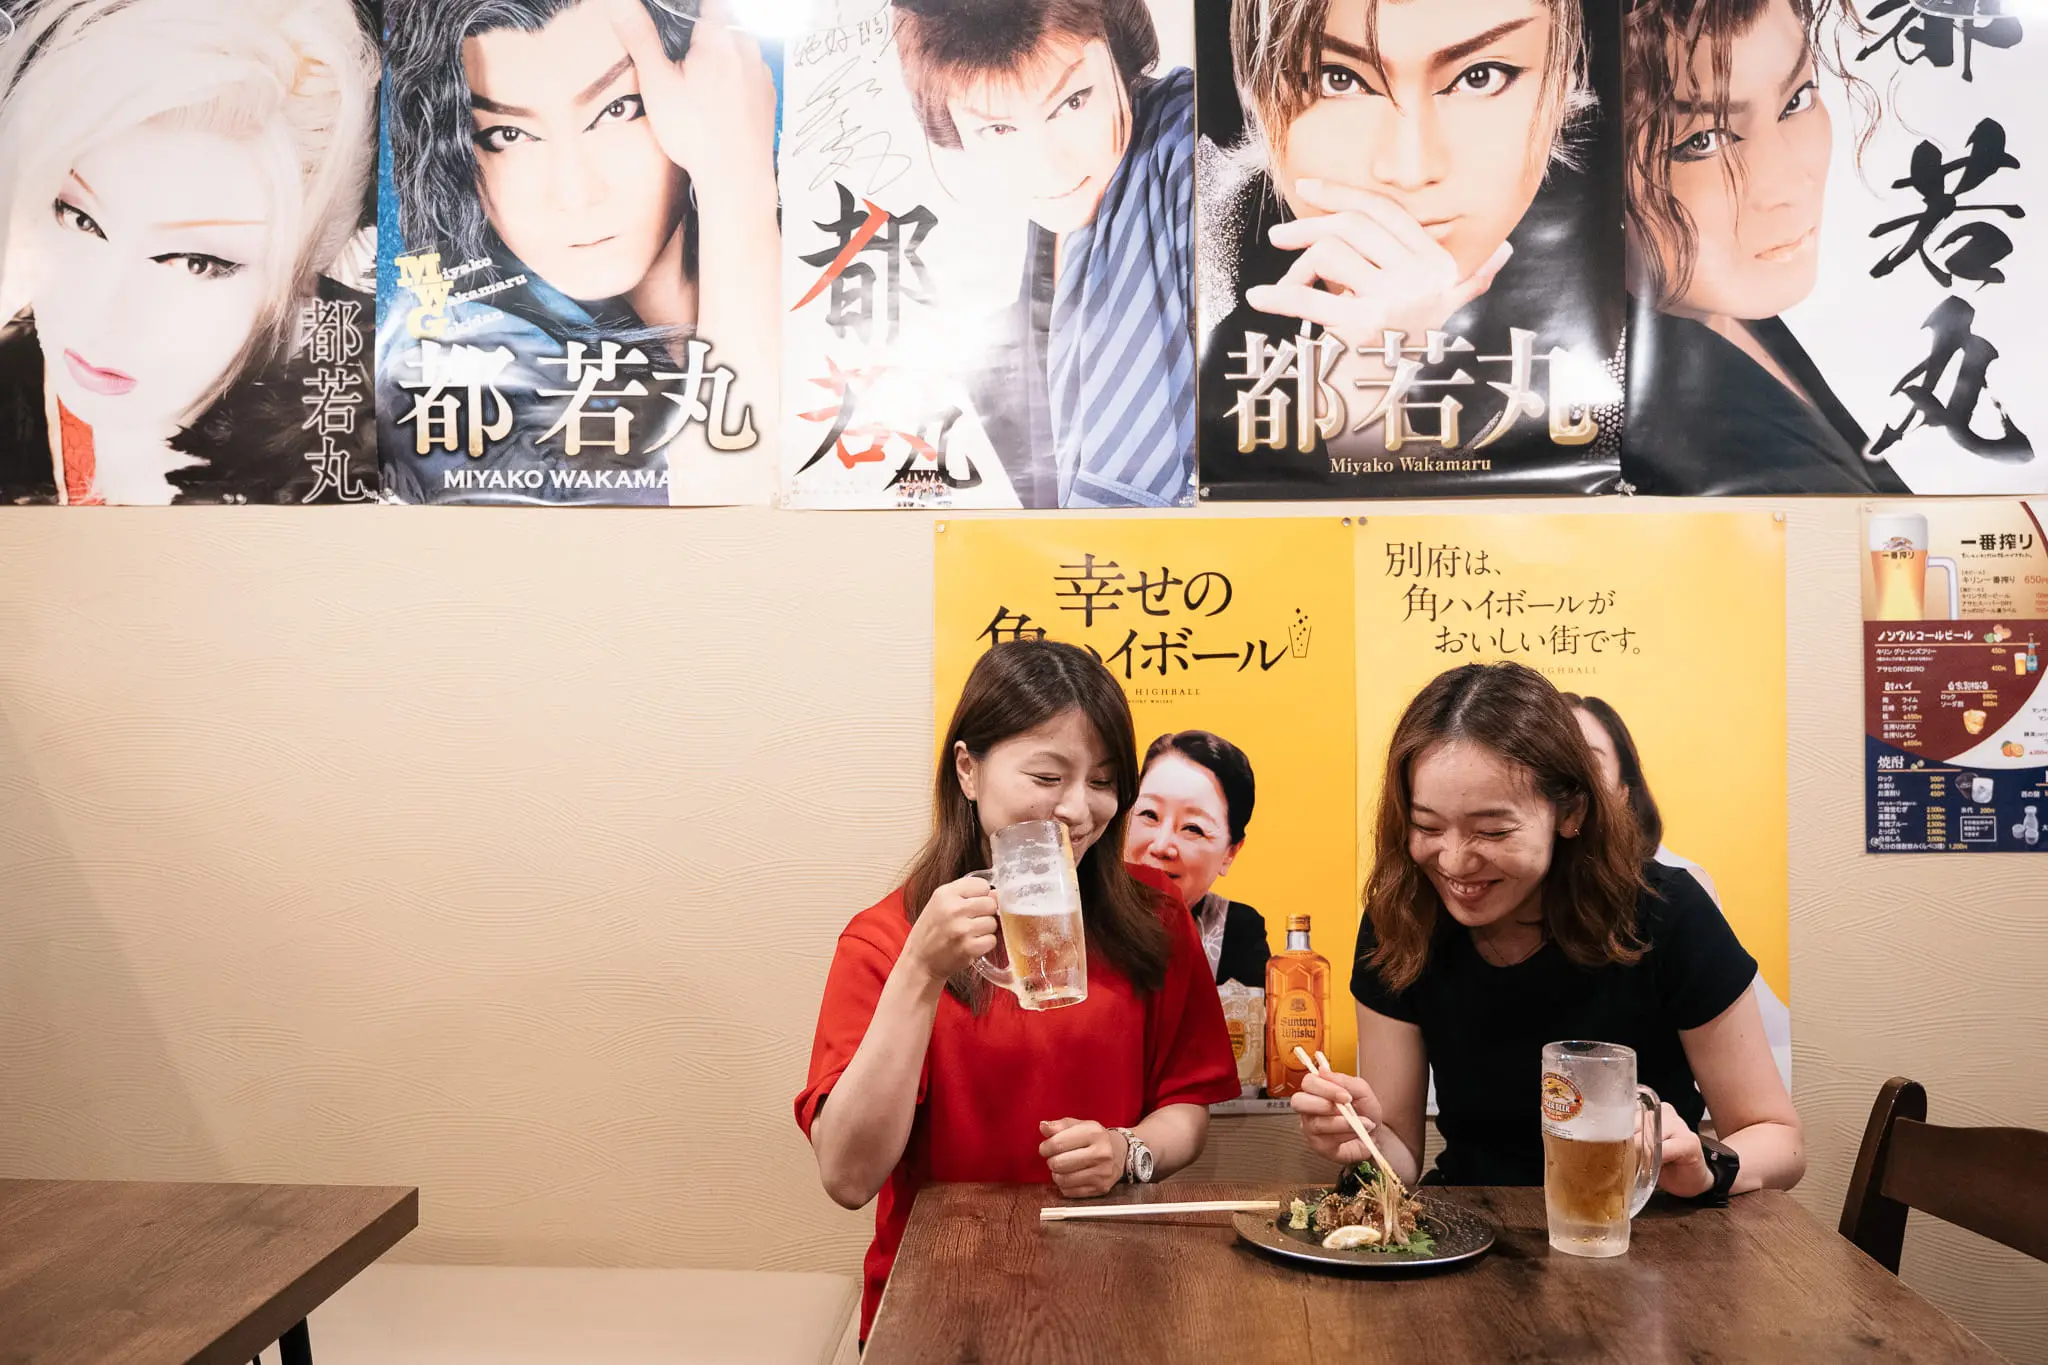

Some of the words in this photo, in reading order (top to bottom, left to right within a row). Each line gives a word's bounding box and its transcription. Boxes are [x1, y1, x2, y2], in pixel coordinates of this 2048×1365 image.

[301, 298, 366, 503] 都若丸
[397, 338, 759, 458] 都若丸
[1225, 330, 1600, 454] 都若丸
[1330, 458, 1394, 475] Miyako
[1400, 457, 1491, 471] Wakamaru
[443, 470, 544, 489] MIYAKO
[1961, 533, 2033, 551] 一番搾り
[1385, 541, 1502, 579] 別府は、
[1053, 553, 1233, 628] 幸せの
[1402, 583, 1616, 623] 角ハイボールが
[1434, 624, 1642, 656] おいしい街です。
[1877, 630, 1974, 642] ノンアルコールビール
[1135, 688, 1201, 696] HIGHBALL
[1877, 755, 1905, 769] 焼酎
[1279, 1017, 1317, 1028] Suntory
[1282, 1027, 1316, 1040] Whisky
